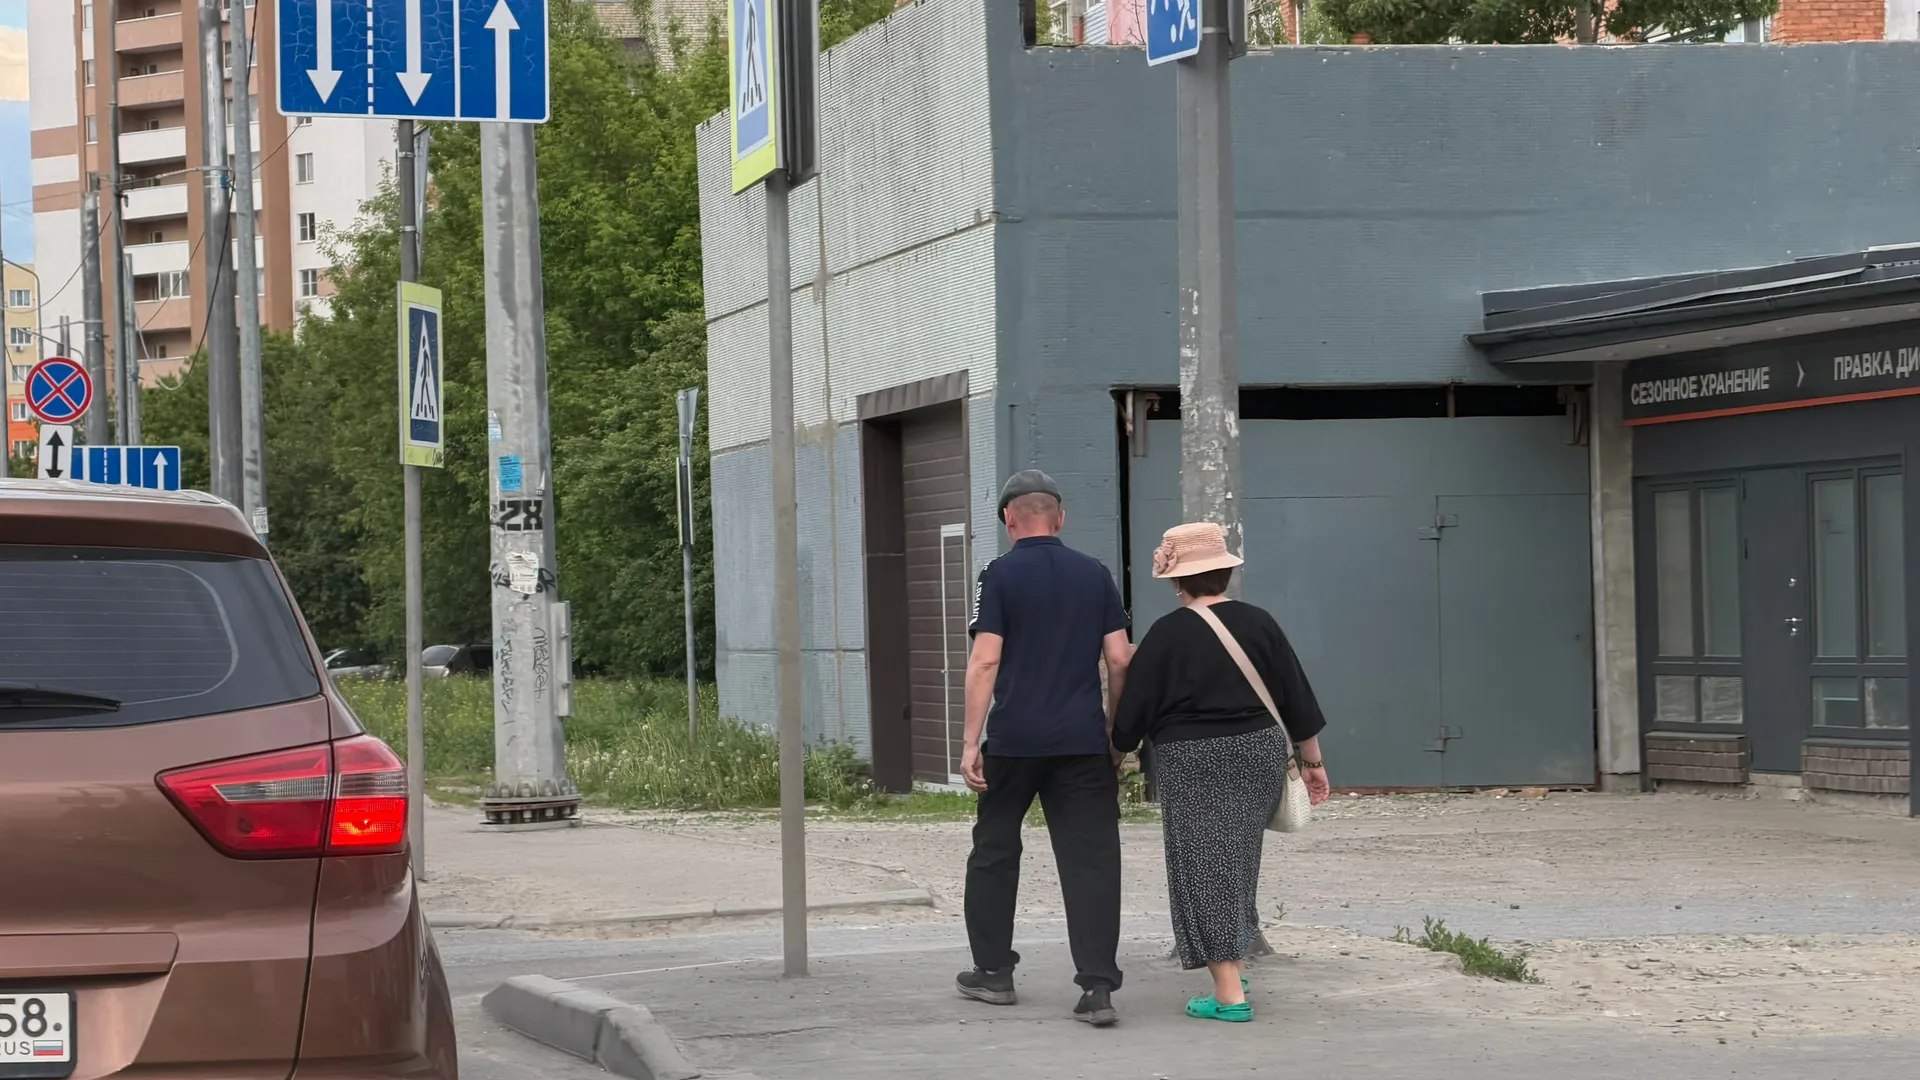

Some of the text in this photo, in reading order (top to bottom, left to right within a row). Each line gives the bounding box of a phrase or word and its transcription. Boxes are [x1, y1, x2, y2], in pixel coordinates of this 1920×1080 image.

[1834, 346, 1920, 381] ПРАВКА ДИ
[1631, 366, 1770, 405] СЕЗОННОЕ ХРАНЕНИЕ
[0, 1041, 31, 1056] US
